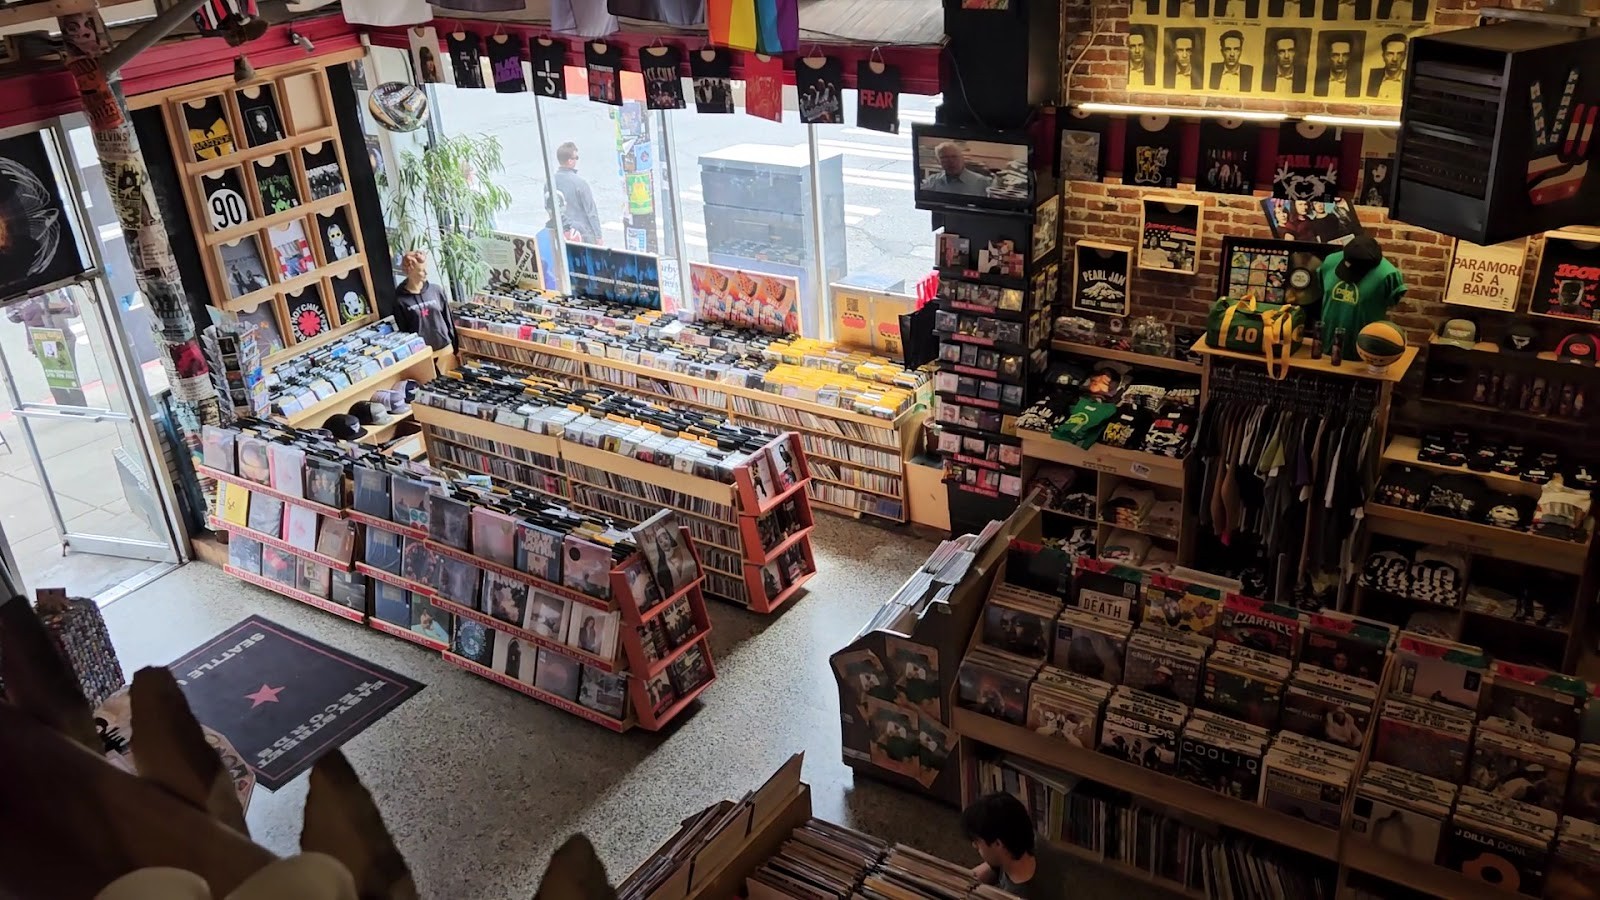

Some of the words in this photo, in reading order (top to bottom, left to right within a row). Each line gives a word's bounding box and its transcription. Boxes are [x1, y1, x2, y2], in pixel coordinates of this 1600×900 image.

[860, 89, 894, 109] FEAR
[212, 193, 242, 228] 90
[1082, 269, 1108, 282] PEARL
[1108, 271, 1126, 286] JAM
[1463, 283, 1504, 298] BAND!
[1470, 271, 1484, 283] IS
[1489, 274, 1500, 286] A
[1234, 325, 1259, 344] 10
[1083, 598, 1122, 618] DEATH
[1233, 611, 1294, 637] CZARFACE
[187, 632, 266, 681] SEATTLE
[338, 680, 387, 714] EASY
[257, 681, 372, 759] RECORDS
[1106, 711, 1147, 731] BEASTIE
[1148, 724, 1175, 740] BOYS
[257, 713, 337, 769] STREET
[1182, 741, 1258, 771] COOLIO
[1463, 830, 1495, 846] DILLA
